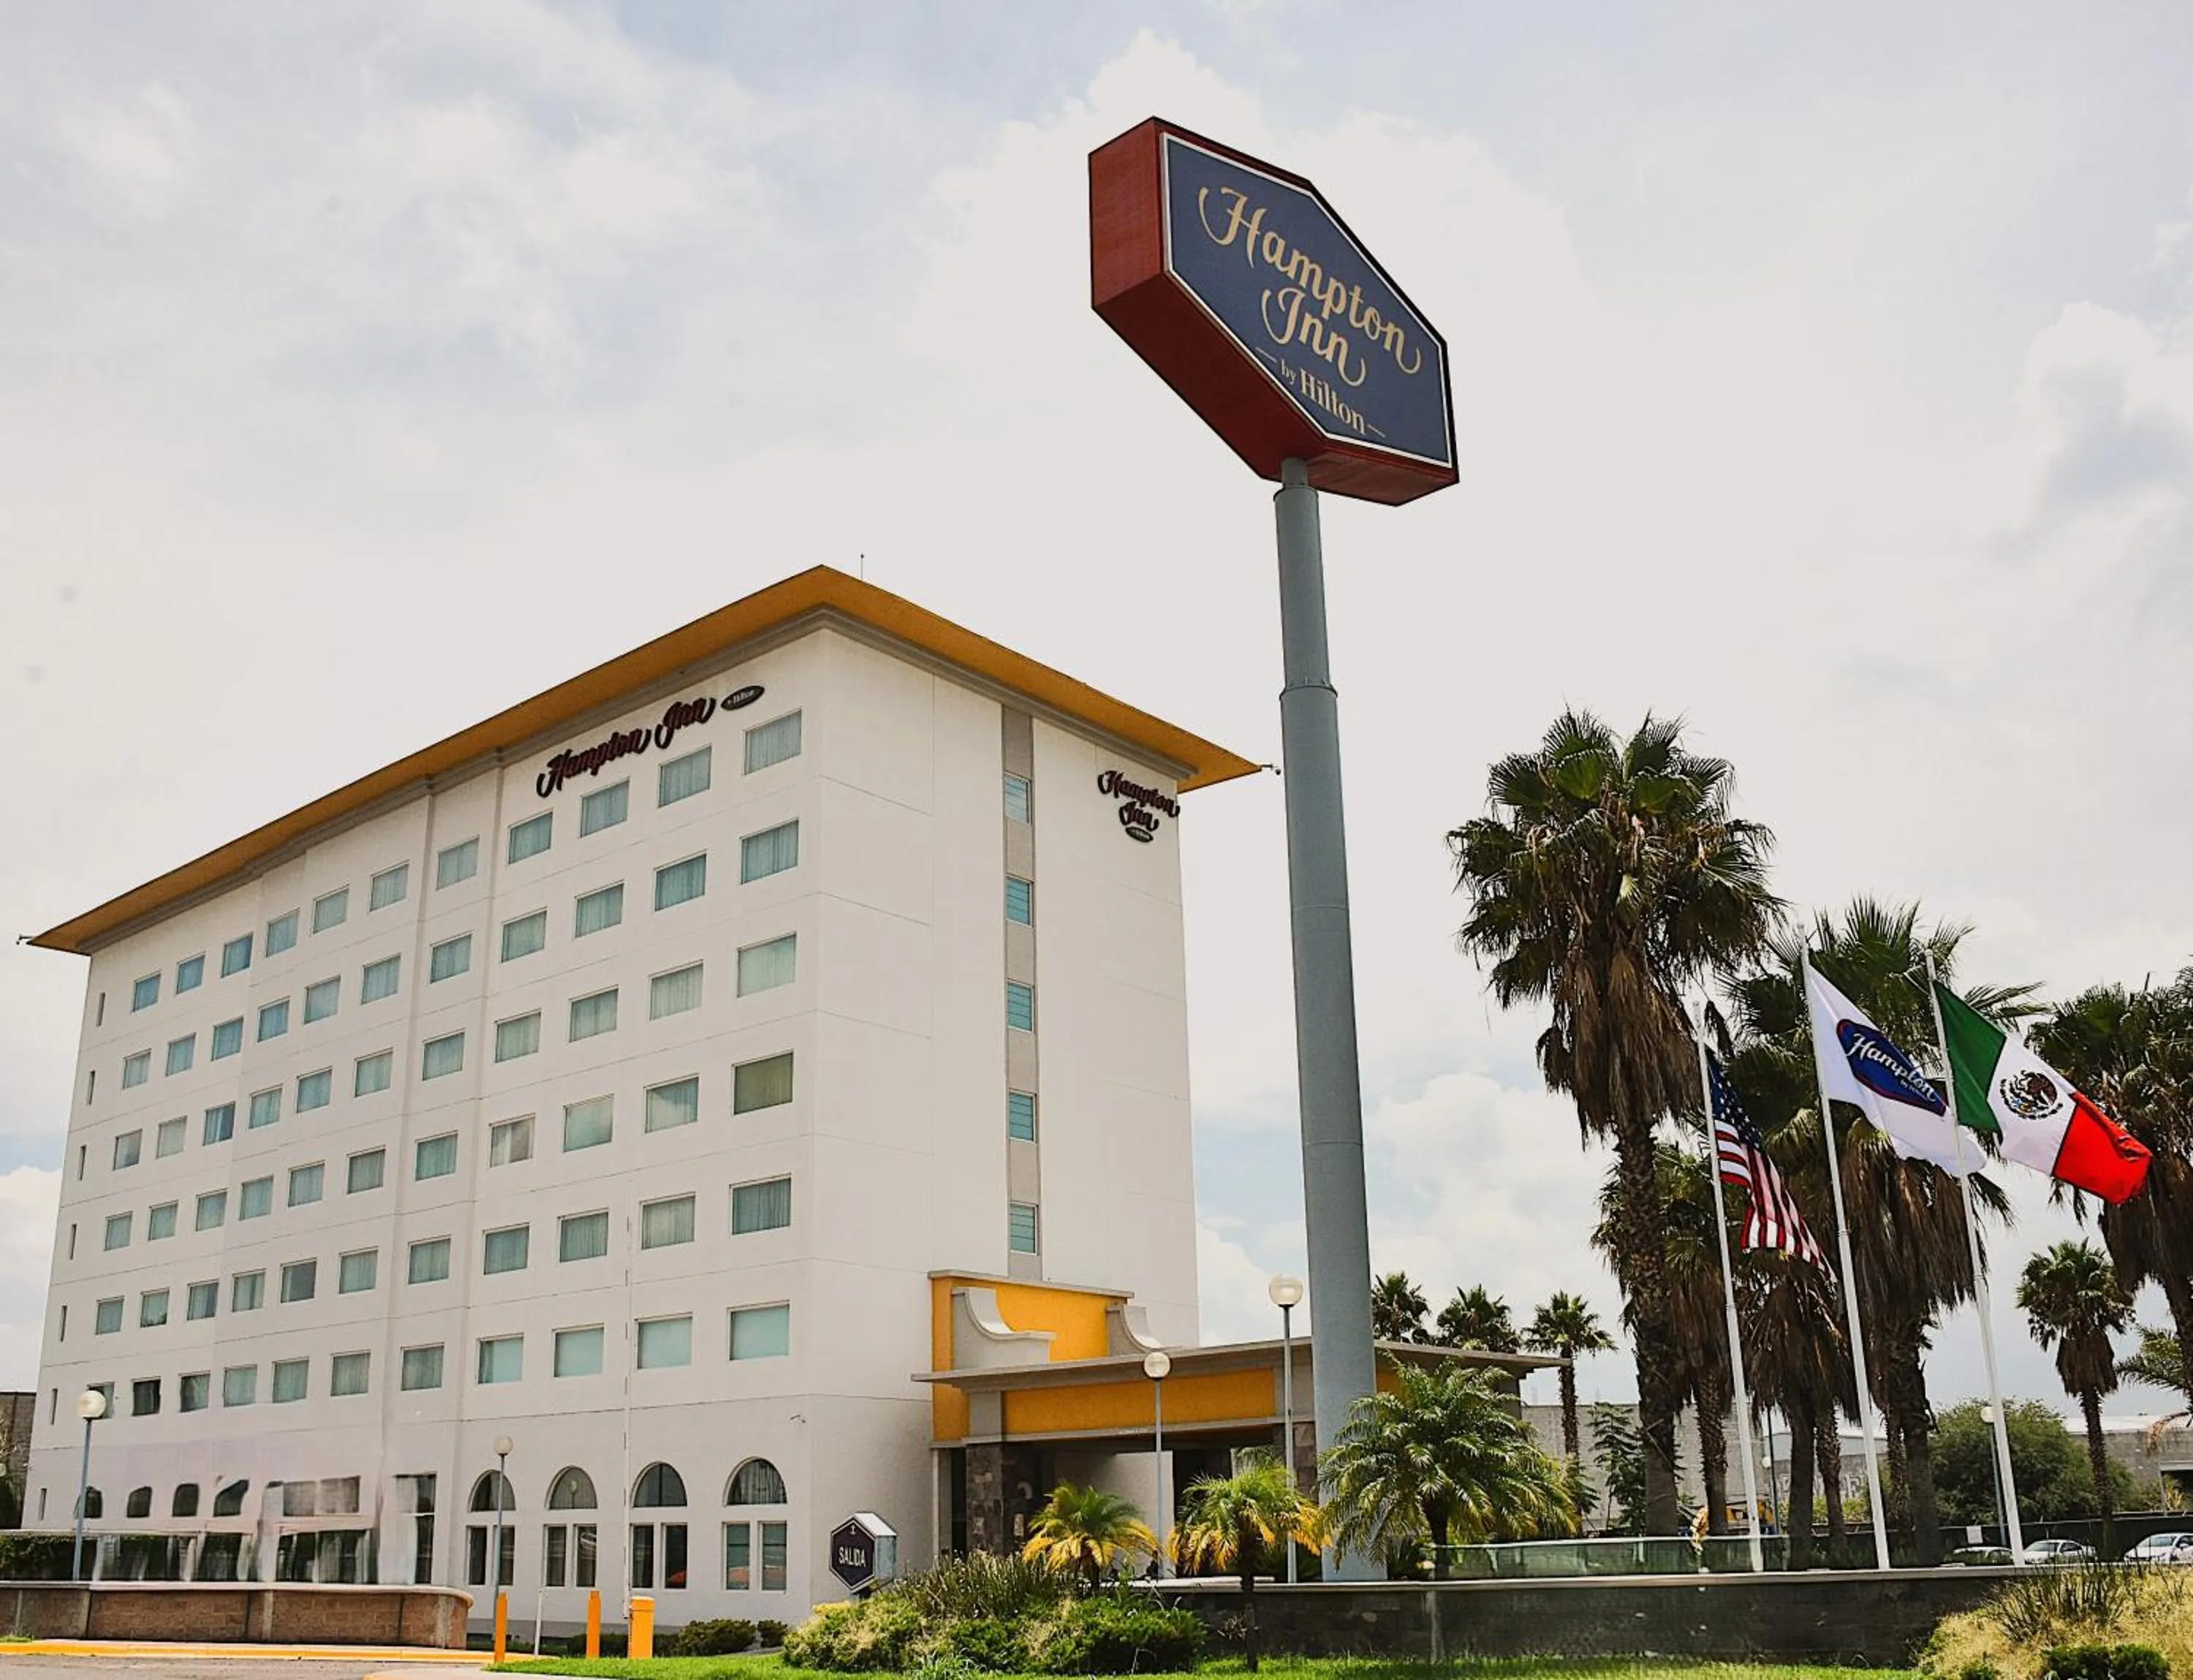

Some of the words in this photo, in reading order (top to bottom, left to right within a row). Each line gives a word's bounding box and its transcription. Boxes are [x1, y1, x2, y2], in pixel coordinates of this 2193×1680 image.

[1198, 186, 1421, 374] Hampton
[1262, 287, 1366, 387] Inn
[1281, 358, 1296, 385] by
[1299, 368, 1366, 436] Hilton
[536, 729, 651, 798] Hampton
[655, 697, 716, 749] Inn
[1098, 770, 1181, 818] Hampton
[1846, 1032, 1937, 1102] Hampton
[838, 1546, 866, 1567] SALIDA
